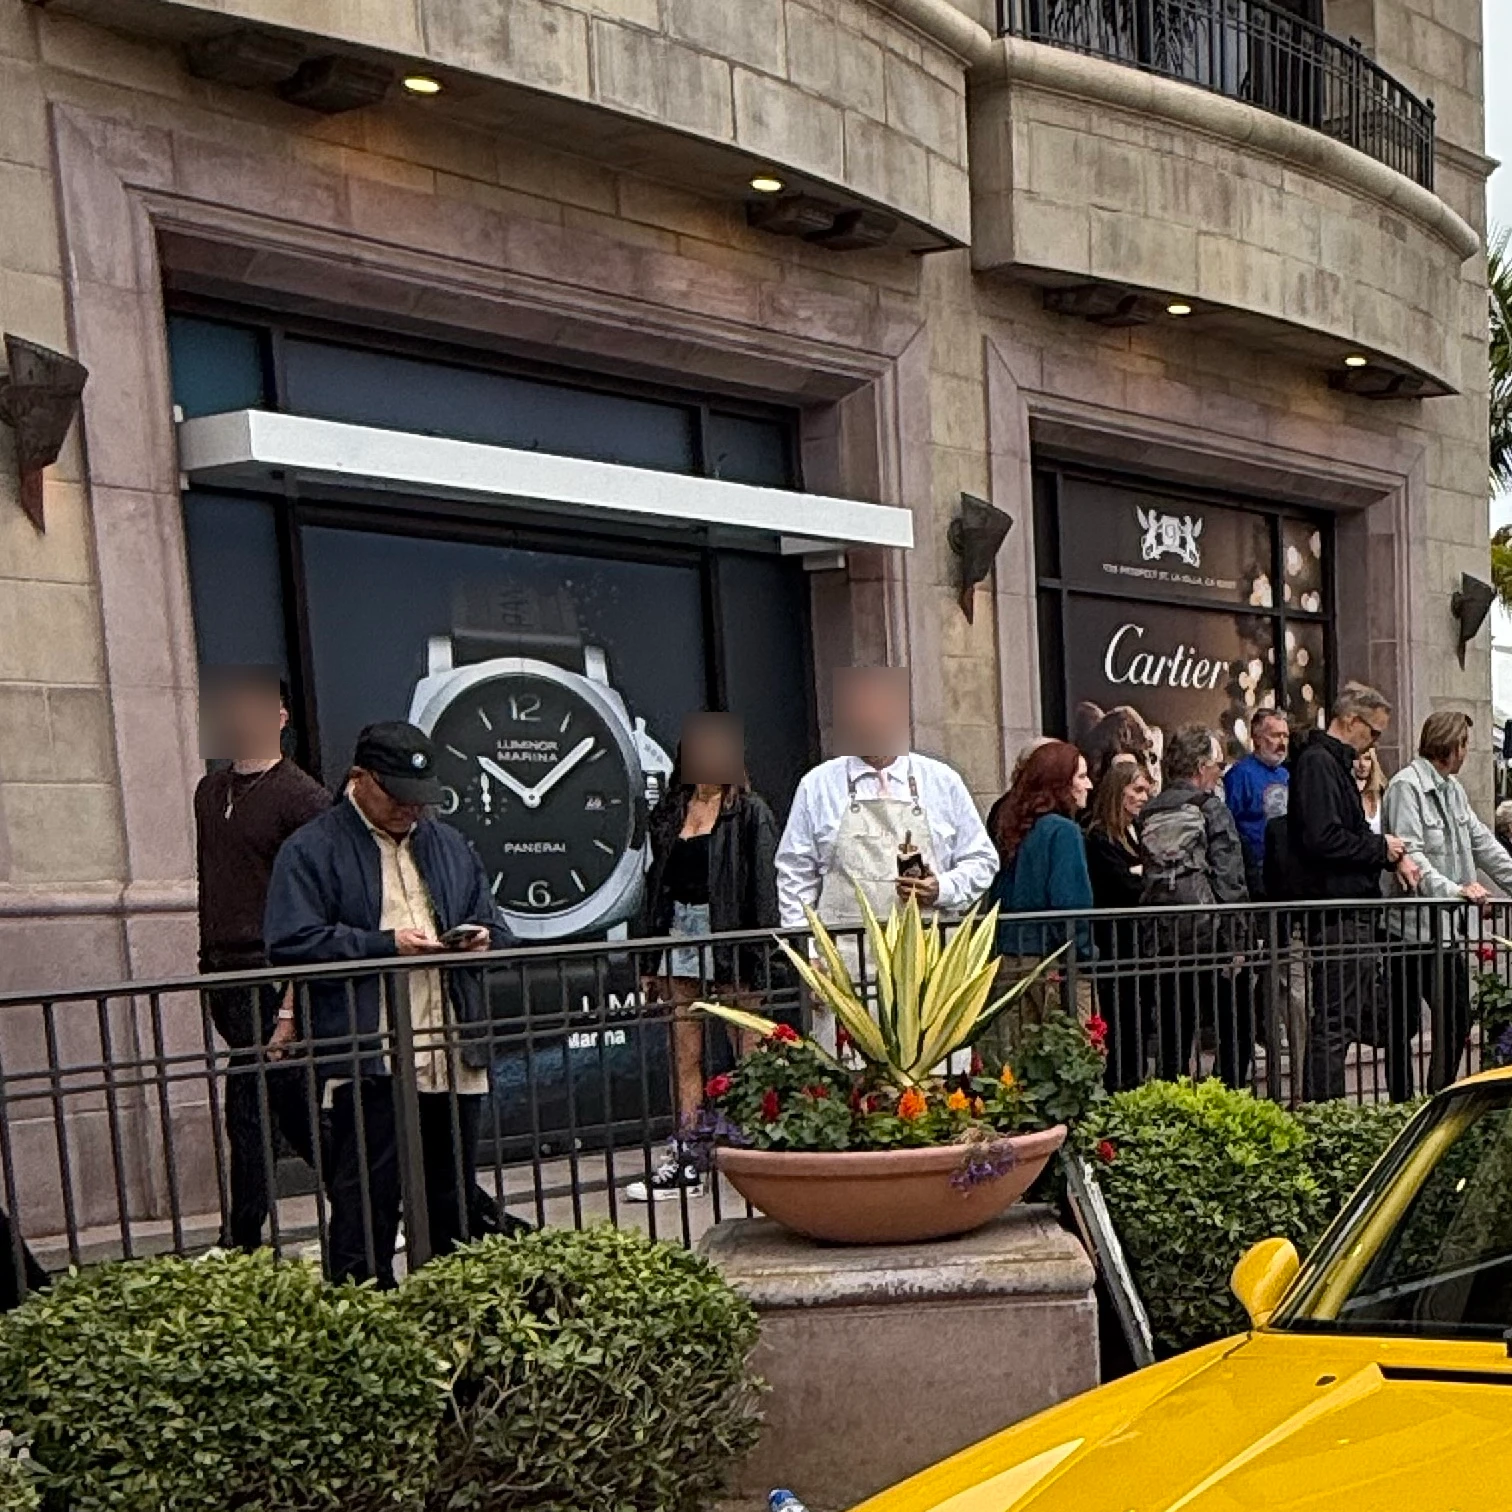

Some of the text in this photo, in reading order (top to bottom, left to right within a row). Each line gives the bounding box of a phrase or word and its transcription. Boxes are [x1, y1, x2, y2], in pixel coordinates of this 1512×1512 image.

[1104, 624, 1229, 689] Cartier
[509, 694, 541, 721] 12
[497, 739, 558, 750] LUMINOR
[497, 751, 558, 762] MARINA
[504, 842, 566, 853] PANERAI
[528, 880, 551, 908] 6
